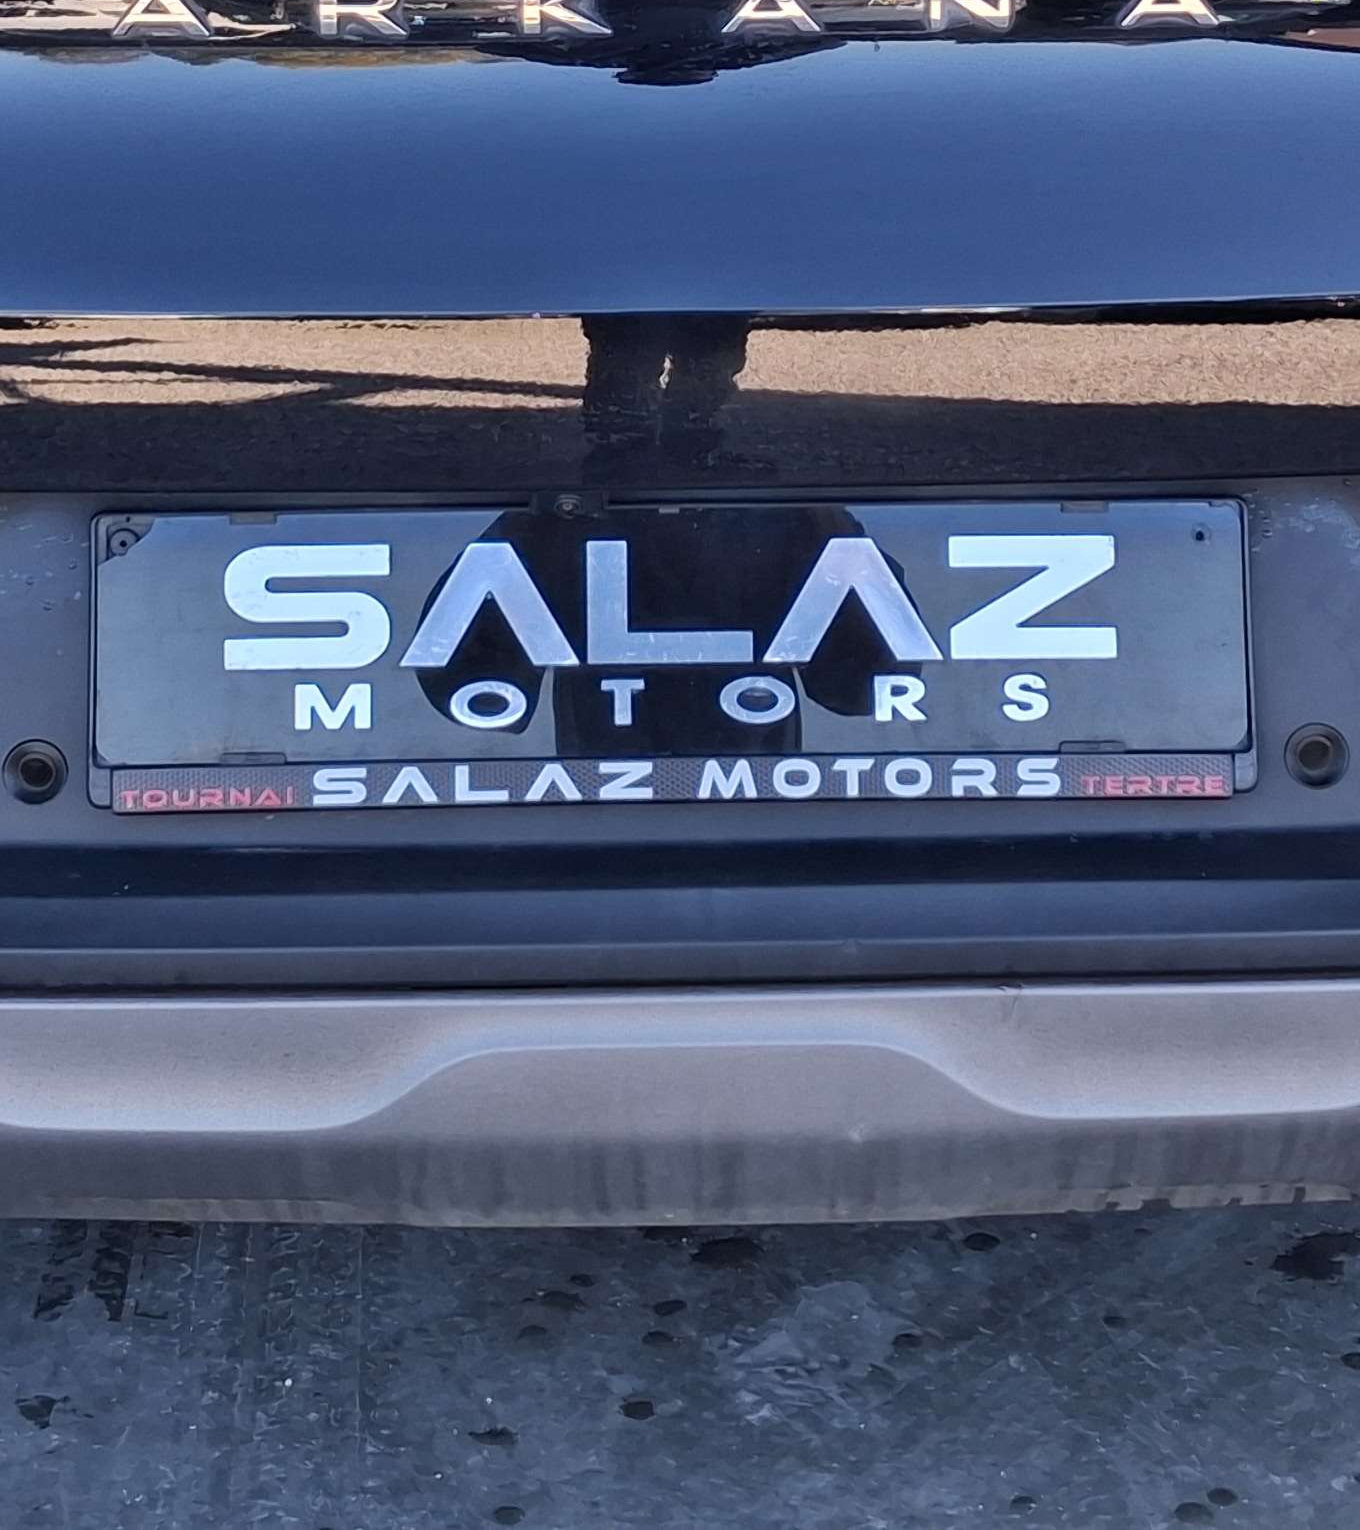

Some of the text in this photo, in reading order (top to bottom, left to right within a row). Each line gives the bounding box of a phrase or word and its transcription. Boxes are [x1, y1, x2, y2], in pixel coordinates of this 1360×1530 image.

[223, 534, 1118, 671] SALAZ
[293, 673, 1050, 731] MOTORS
[120, 757, 1228, 811] TOURNAI SALAZ MOTORS TERTRE
